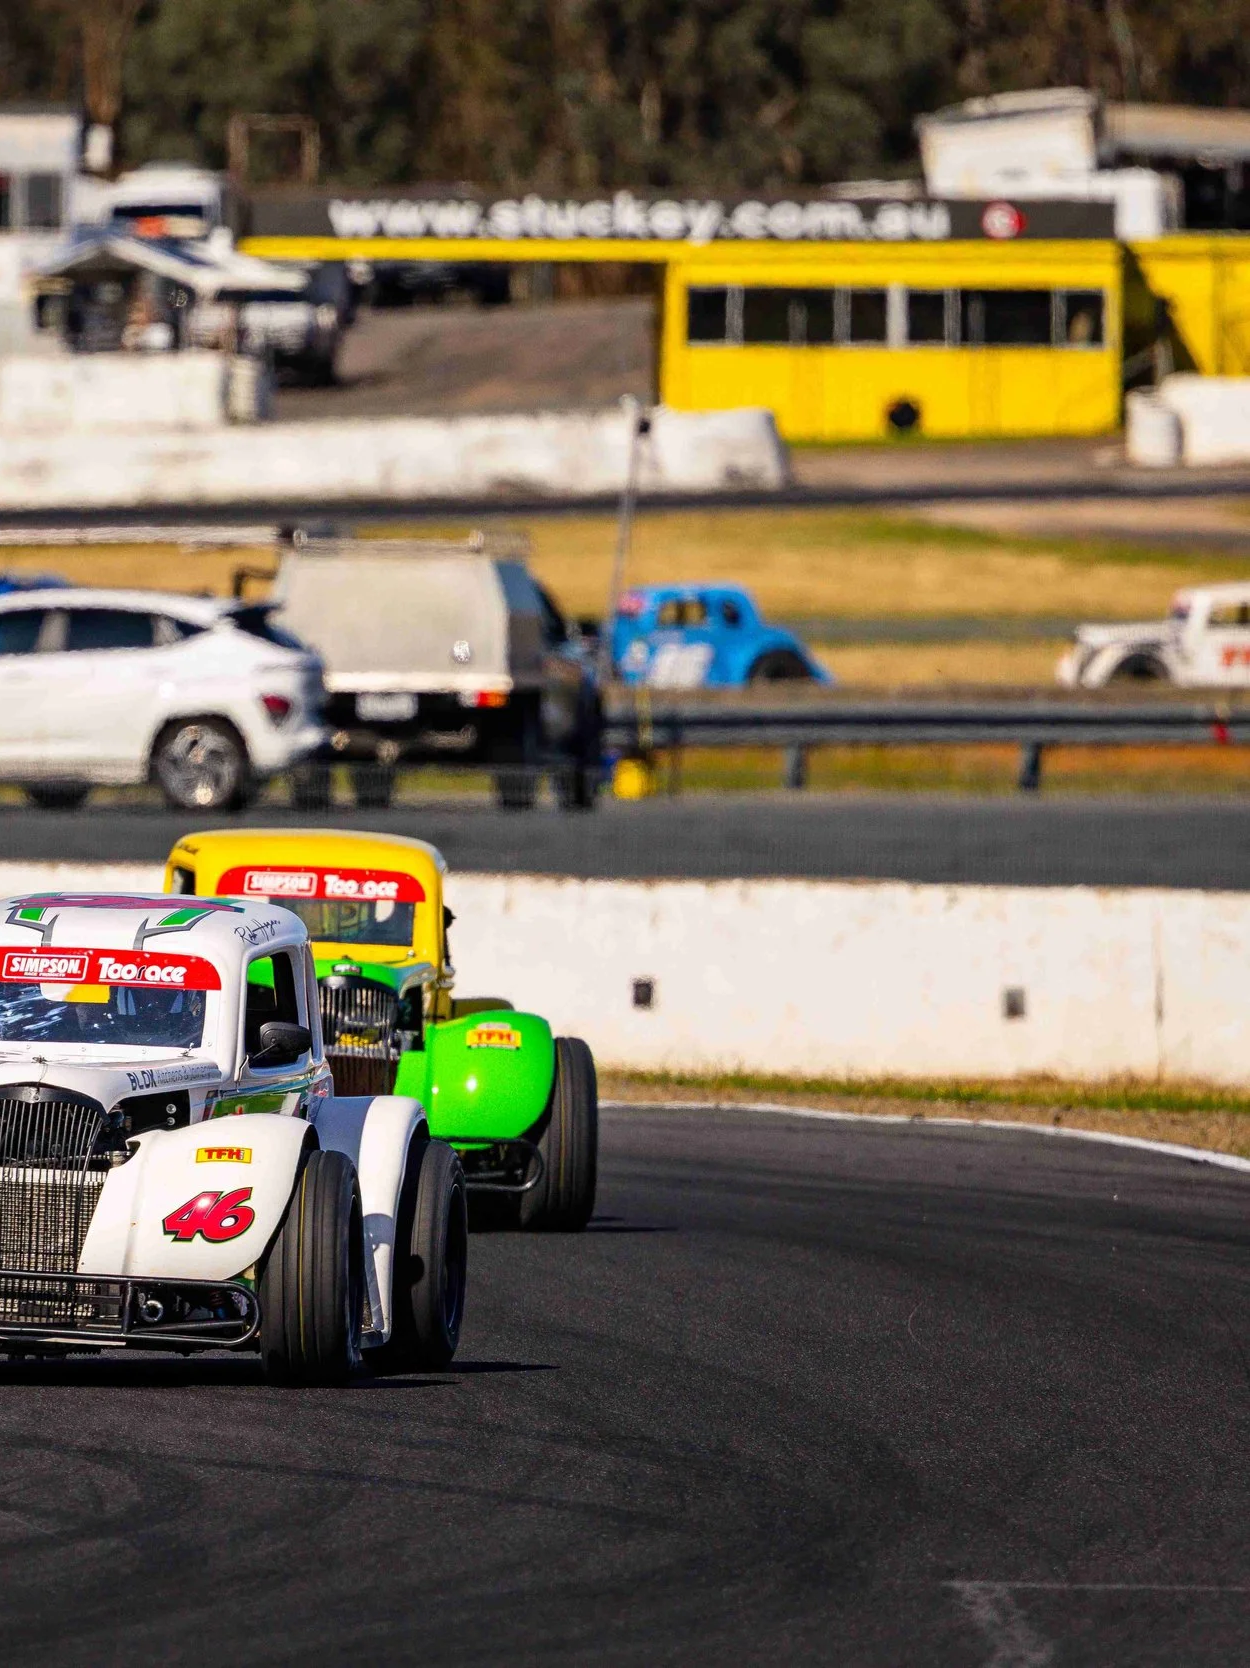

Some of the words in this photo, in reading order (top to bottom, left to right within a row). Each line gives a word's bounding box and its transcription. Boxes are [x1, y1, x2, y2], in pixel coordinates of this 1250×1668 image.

[329, 192, 949, 245] www.stuckey.com.au
[10, 956, 80, 975] SIMPSON
[205, 1147, 241, 1160] TFH
[162, 1187, 255, 1244] 46
